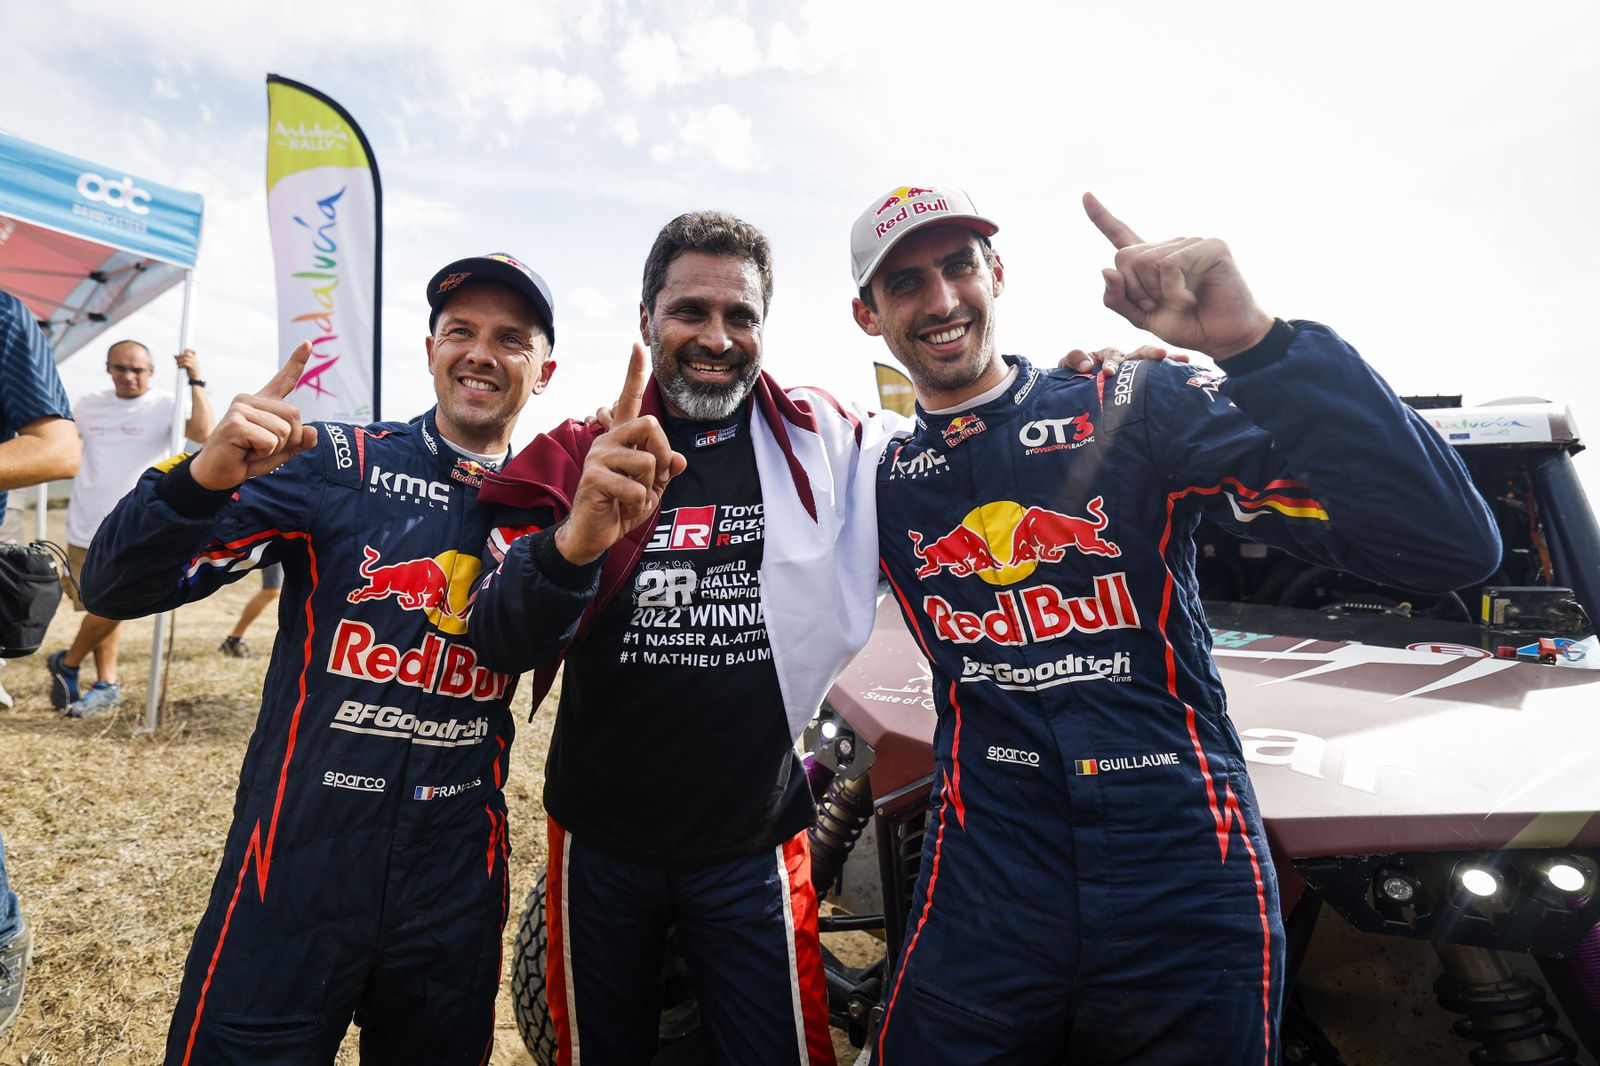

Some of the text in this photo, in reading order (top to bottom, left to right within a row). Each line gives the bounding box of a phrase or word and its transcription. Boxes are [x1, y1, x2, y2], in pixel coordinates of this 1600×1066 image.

[875, 198, 949, 238] Red Bull
[1019, 412, 1094, 447] OT3
[325, 424, 352, 470] sparco
[716, 527, 764, 547] Raci
[706, 560, 746, 576] WORLD
[701, 586, 761, 600] CHAMPIO
[630, 607, 681, 628] 2022
[924, 571, 1142, 647] Red Bull
[623, 632, 639, 645] #1
[645, 633, 706, 647] NASSER
[326, 618, 513, 701] Red Bu
[620, 647, 770, 667] #1 MATHIEU BAUM
[1112, 675, 1132, 683] Tires
[864, 692, 900, 703] State
[902, 696, 922, 705] of
[987, 745, 1040, 767] sparco
[1099, 752, 1180, 773] GUILLAUME
[323, 770, 386, 792] sparco
